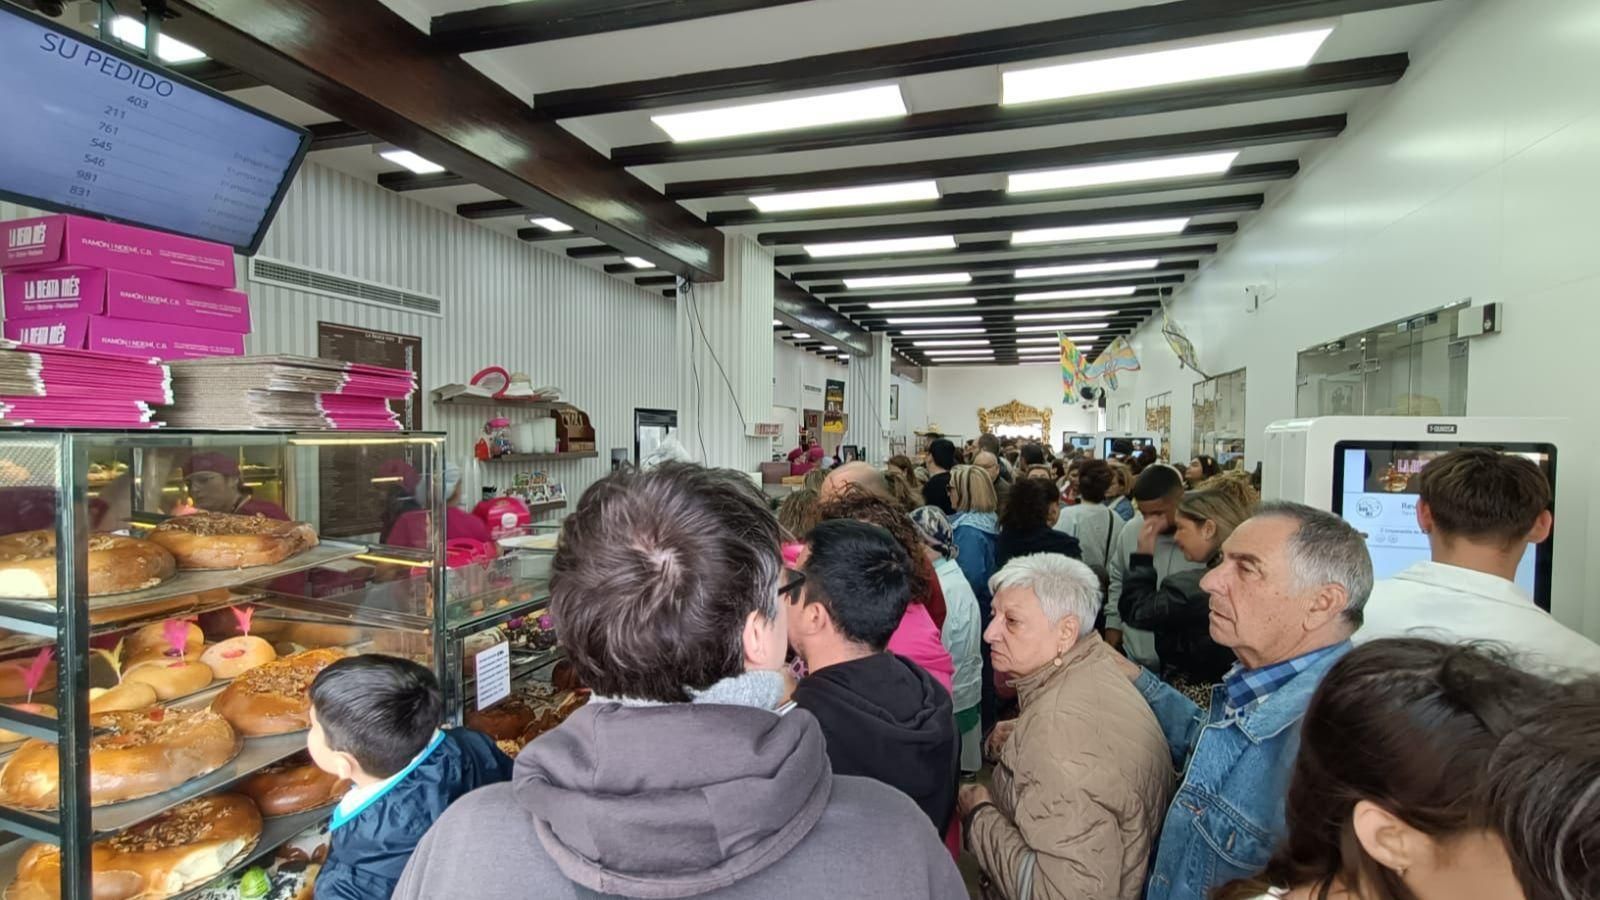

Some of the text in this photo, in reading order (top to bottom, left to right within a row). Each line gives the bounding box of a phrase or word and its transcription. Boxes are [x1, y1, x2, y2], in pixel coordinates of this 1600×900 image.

[40, 33, 174, 97] SU PEDIDO
[127, 95, 149, 109] 403
[103, 105, 126, 119] 211
[98, 121, 119, 135] 761
[90, 138, 113, 152] 545
[83, 154, 105, 168] 546
[76, 169, 98, 182] 981
[69, 185, 91, 197] 831
[81, 237, 109, 249] RAMÓN
[24, 274, 80, 300] LA BEATA INÉS
[1397, 459, 1410, 473] LA
